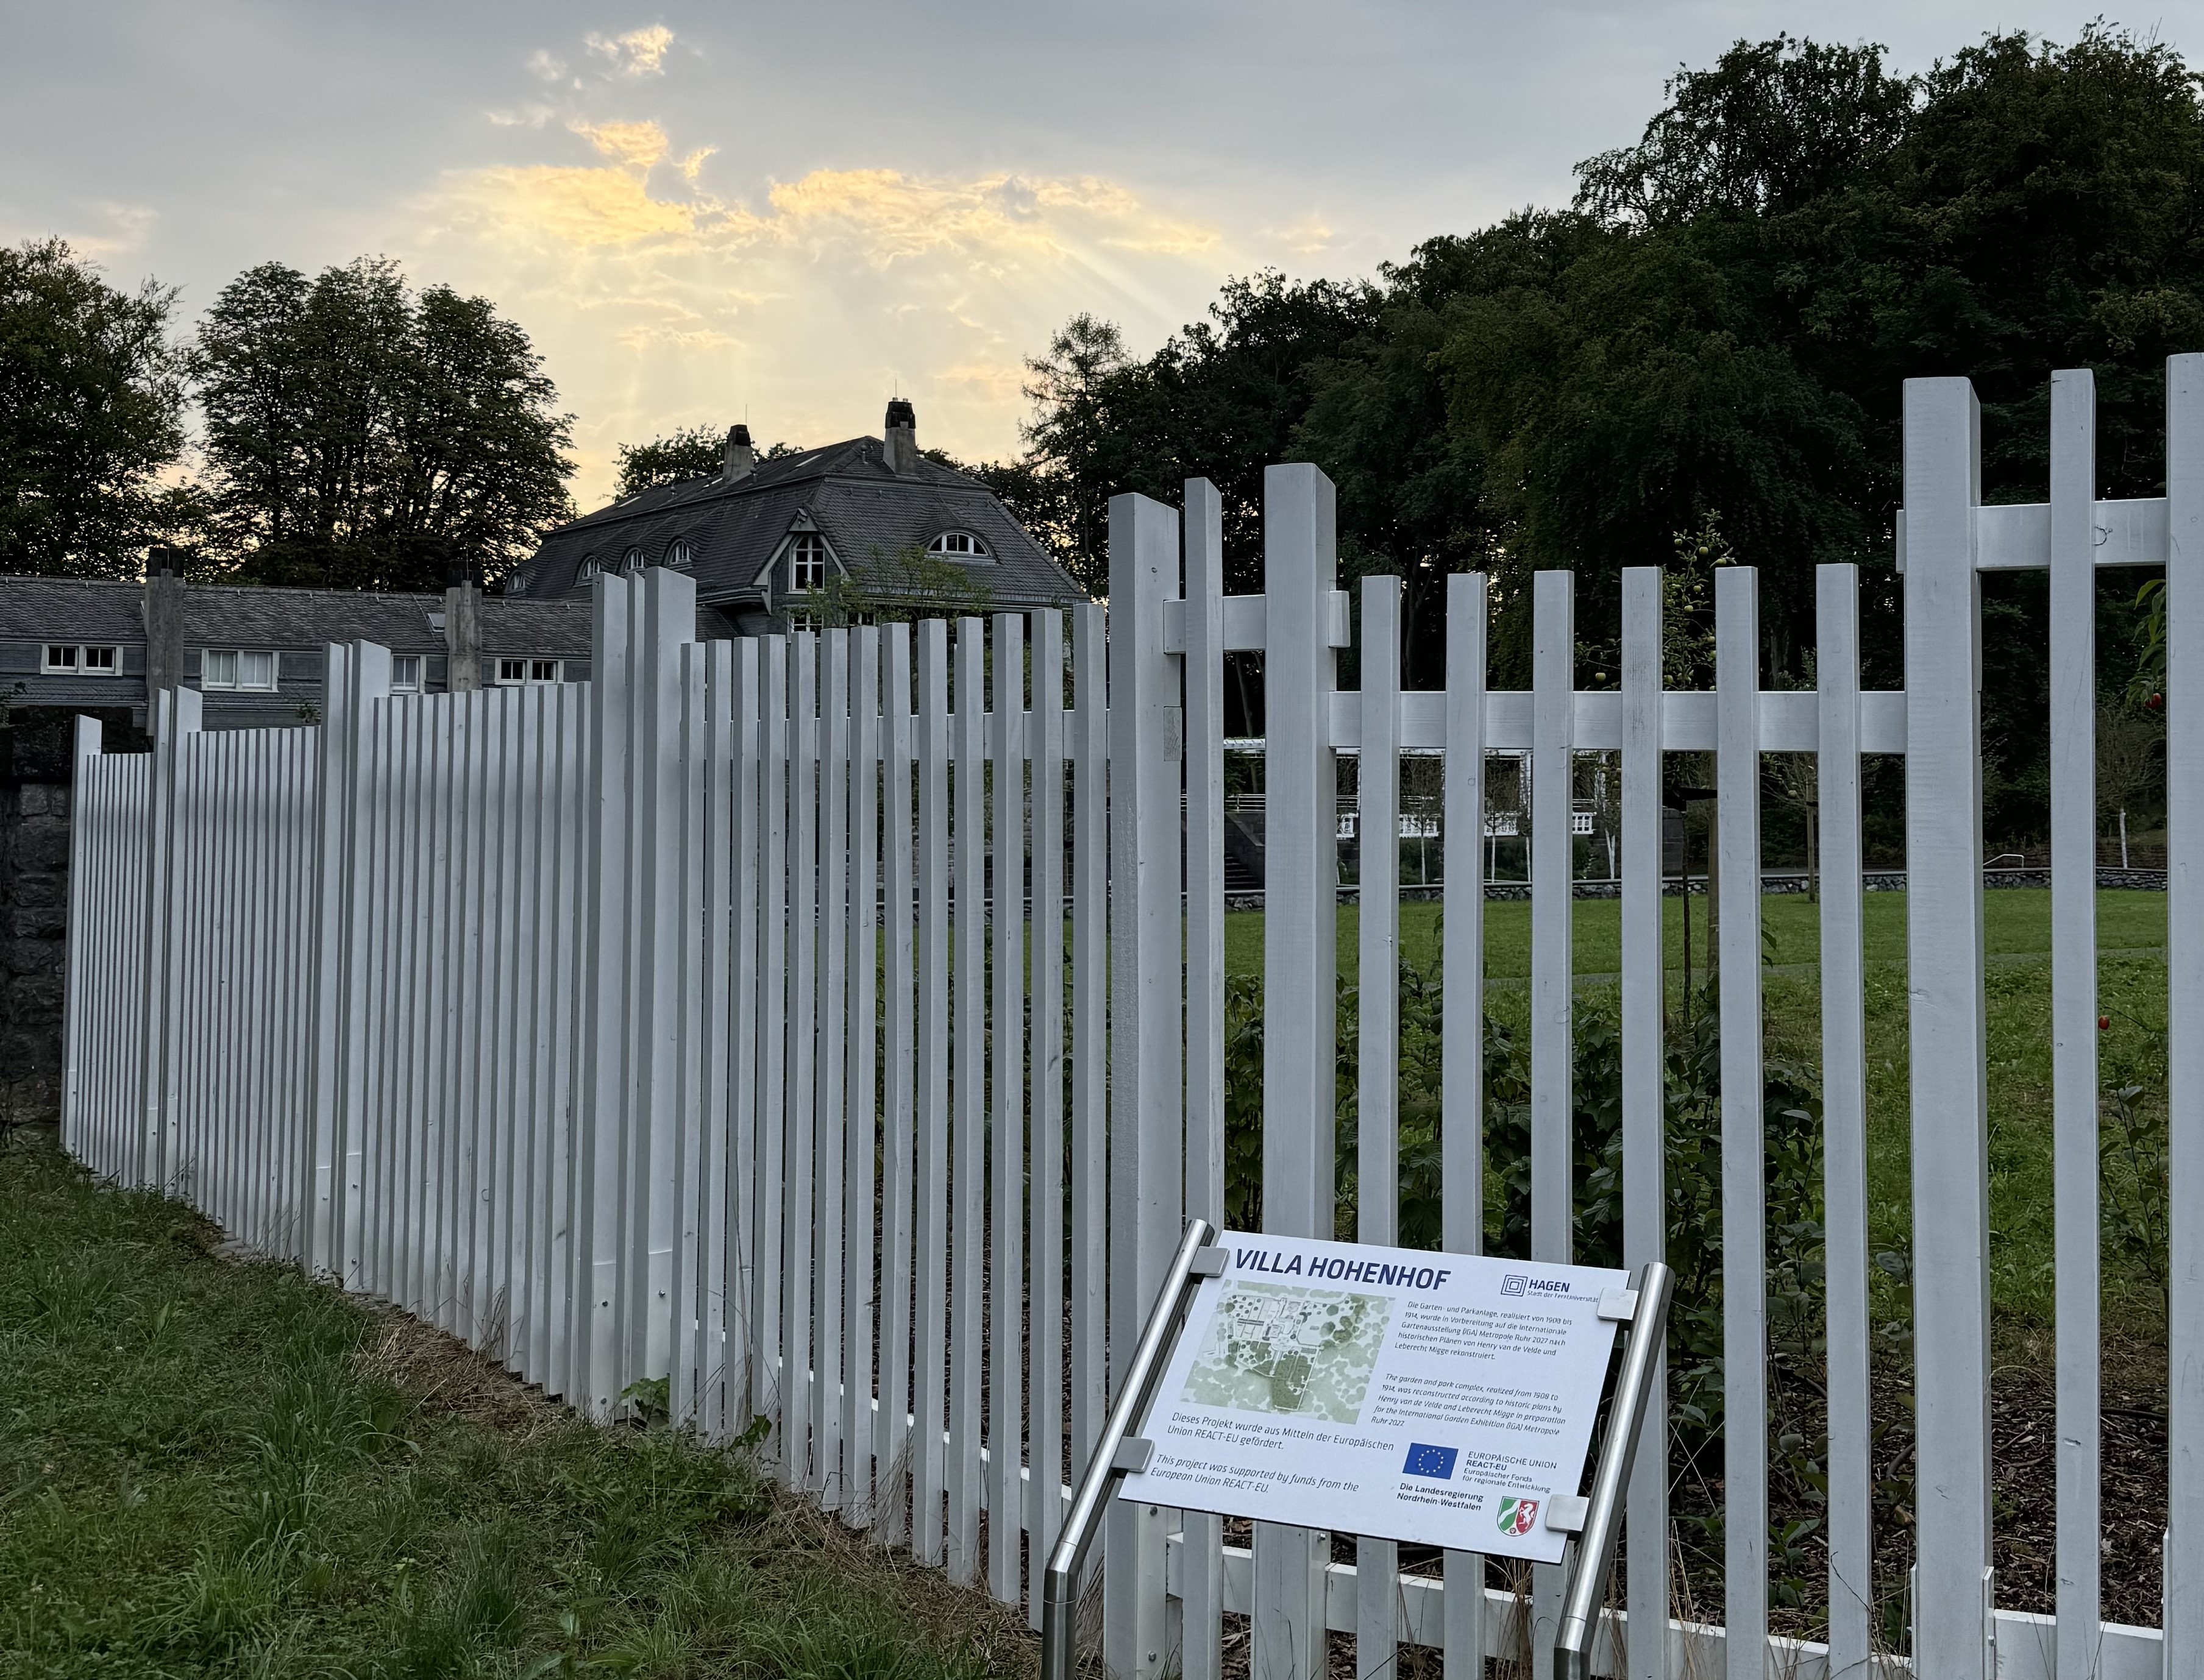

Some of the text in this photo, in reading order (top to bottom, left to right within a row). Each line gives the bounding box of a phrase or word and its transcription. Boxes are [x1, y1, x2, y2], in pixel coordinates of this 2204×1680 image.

[1236, 1248, 1451, 1289] VILLA HOHENHOF
[1529, 1279, 1569, 1292] HAGEN
[1460, 1306, 1498, 1317] Parkanlage,
[1401, 1321, 1460, 1335] Gartenausstellung
[1479, 1330, 1513, 1340] Metropole
[1451, 1316, 1493, 1328] Vorbereitung
[1395, 1342, 1427, 1352] Leberecht
[1428, 1346, 1449, 1355] Migge
[1398, 1331, 1437, 1341] historischen
[1438, 1336, 1462, 1345] Plänen
[1477, 1341, 1498, 1350] Henry
[1454, 1383, 1484, 1392] complex,
[1378, 1395, 1398, 1405] Henry
[1457, 1405, 1491, 1415] Leberecht
[1493, 1409, 1514, 1419] Migge
[1523, 1414, 1565, 1424] preparation
[1412, 1389, 1460, 1399] reconstructed
[1460, 1395, 1494, 1405] according
[1504, 1399, 1530, 1409] historic
[1552, 1405, 1562, 1414] by
[1398, 1408, 1443, 1420] International
[1444, 1414, 1469, 1423] Garden
[1470, 1417, 1504, 1428] Exhibition
[1505, 1422, 1523, 1431] (IGA)
[1523, 1425, 1559, 1434] Metropole
[1167, 1425, 1283, 1449] Union REACT-EU gefördert.
[1171, 1412, 1393, 1450] Dieses Projekt wurde aus Mitteln der Europäischen
[1466, 1459, 1507, 1470] REACT-EU
[1468, 1451, 1557, 1469] EUROPÄISCHE UNION
[1150, 1467, 1268, 1492] European Union REACT-EU.
[1157, 1454, 1359, 1491] This project was supported by funds from the
[1474, 1478, 1505, 1486] regionale
[1511, 1473, 1532, 1482] Fonds
[1396, 1492, 1481, 1511] Nordrhein-Westfalen
[1415, 1485, 1484, 1502] Landesregierung
